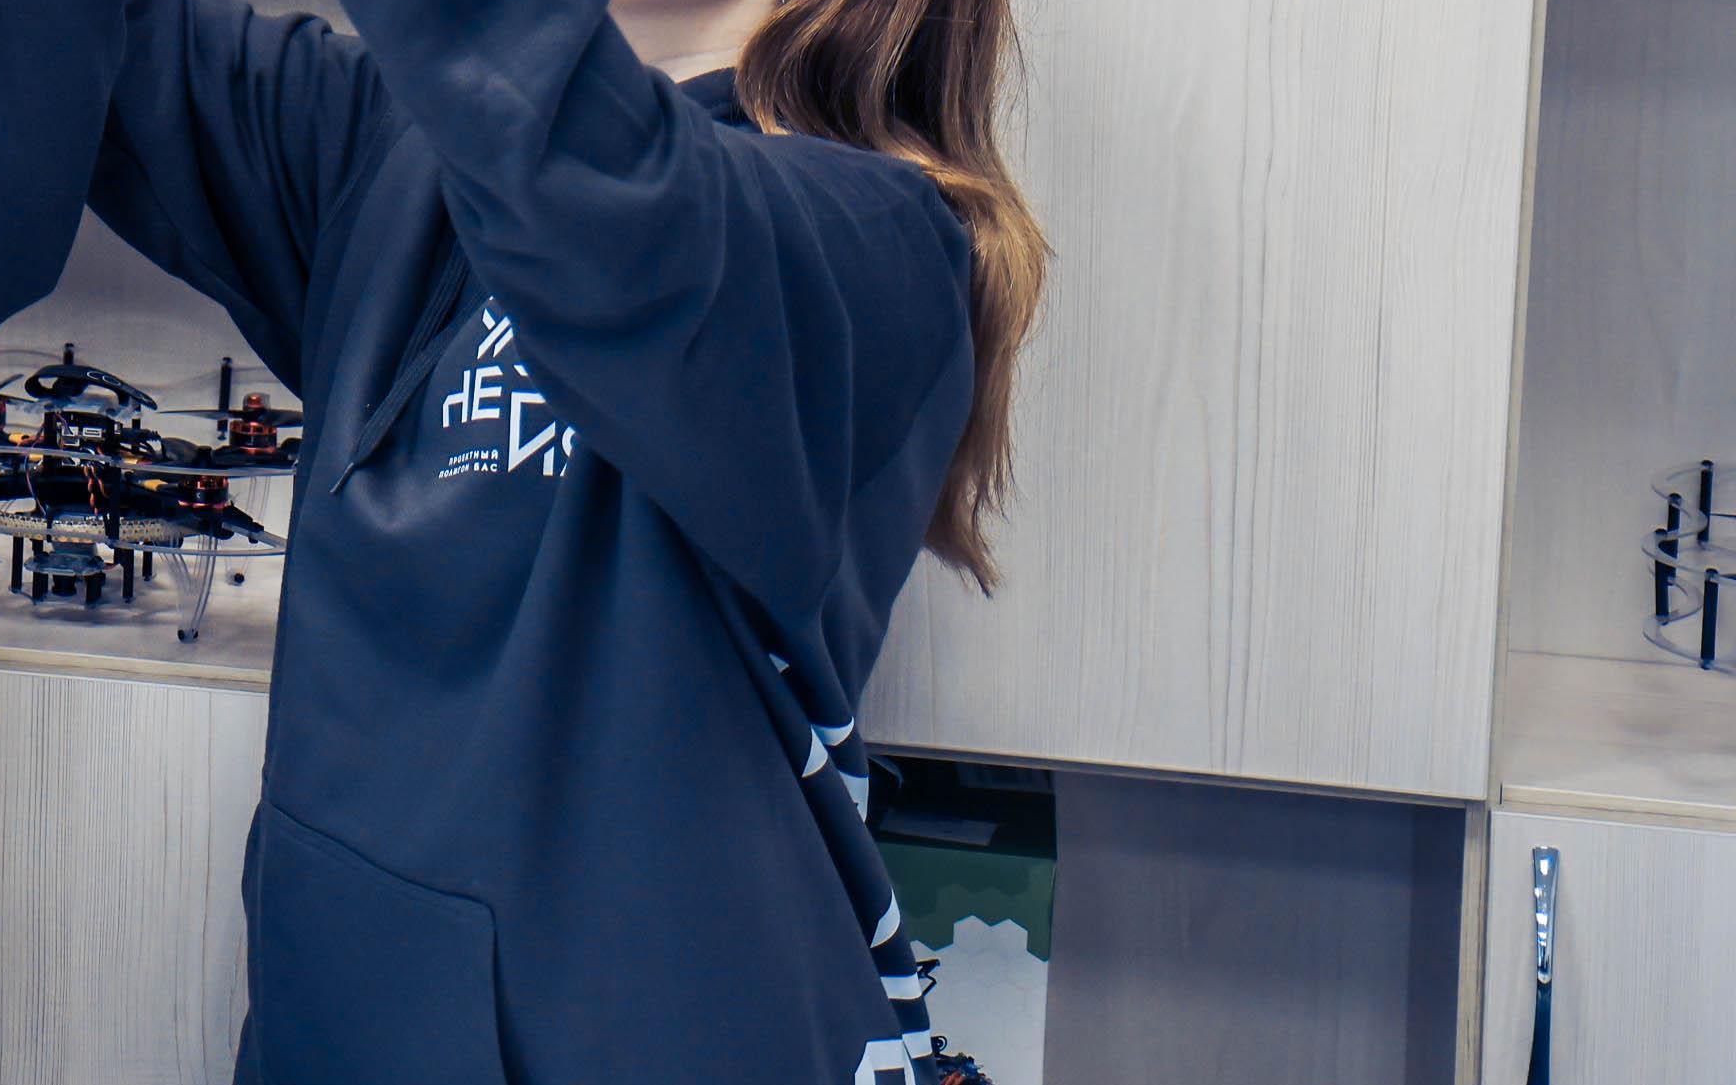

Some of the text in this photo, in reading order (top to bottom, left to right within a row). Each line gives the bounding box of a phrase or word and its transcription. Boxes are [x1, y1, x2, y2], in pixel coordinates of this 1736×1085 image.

[448, 449, 499, 466] ПРОЕКТНЫЙ
[438, 462, 498, 479] ПОЛИГОН БАС
